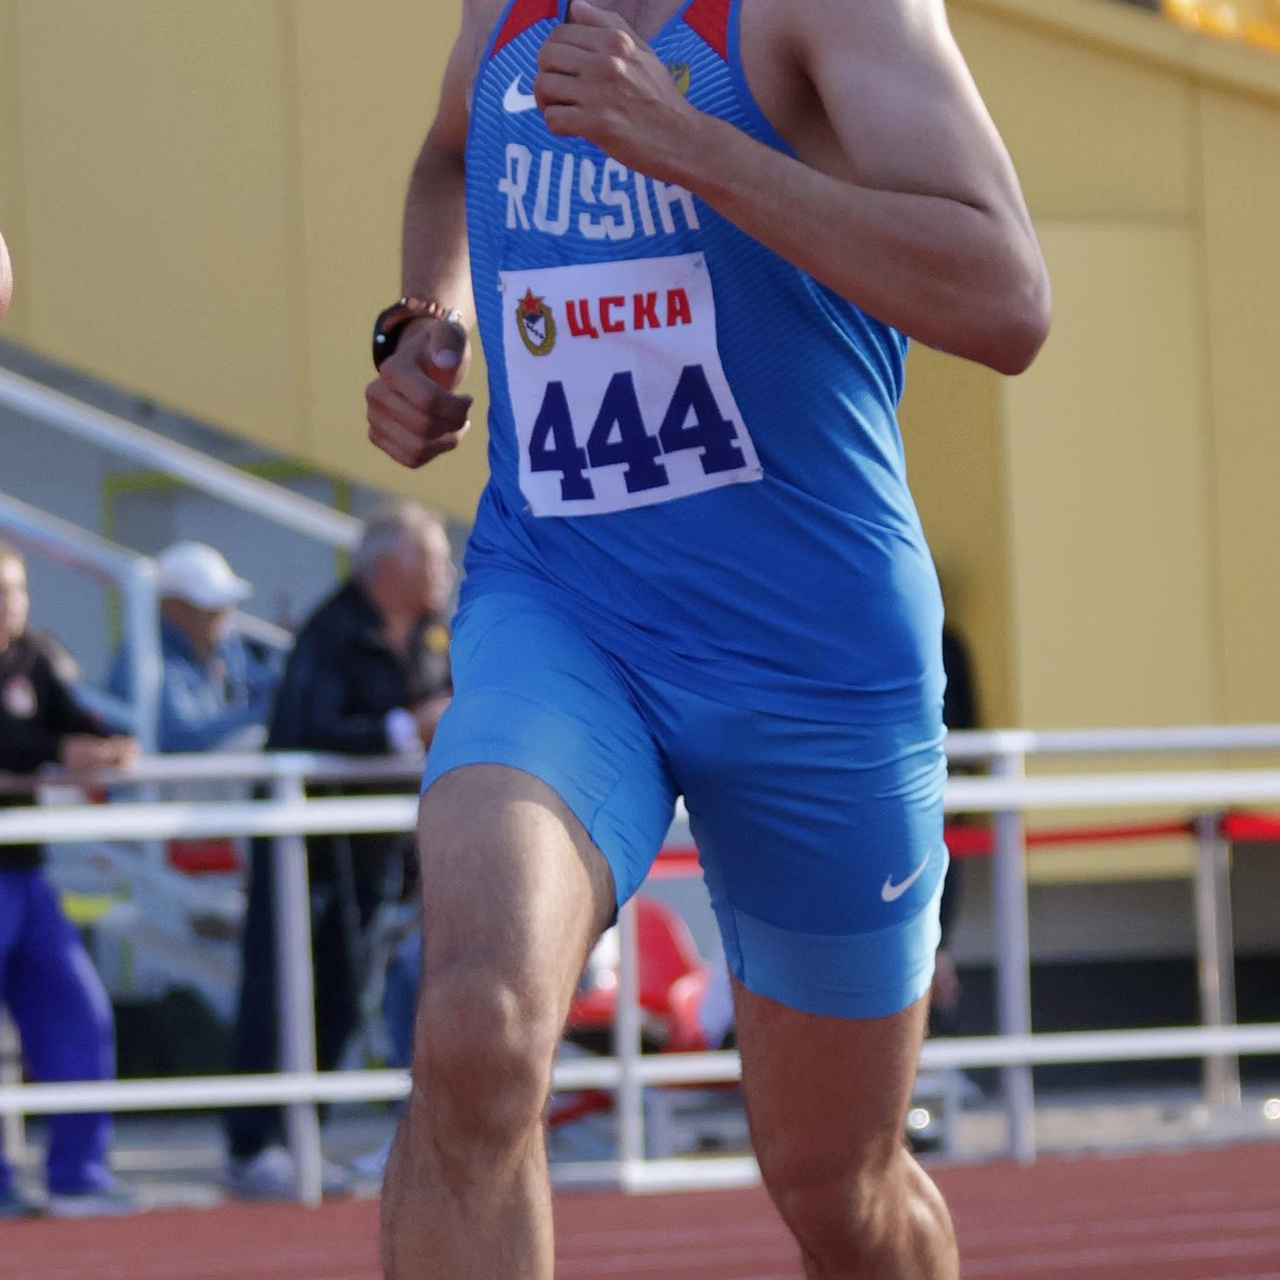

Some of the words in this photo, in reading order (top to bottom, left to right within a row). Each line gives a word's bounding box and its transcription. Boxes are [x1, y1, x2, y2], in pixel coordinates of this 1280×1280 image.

[498, 142, 700, 240] RUSSIA
[566, 288, 693, 339] ЦСКА
[528, 365, 747, 501] 444
